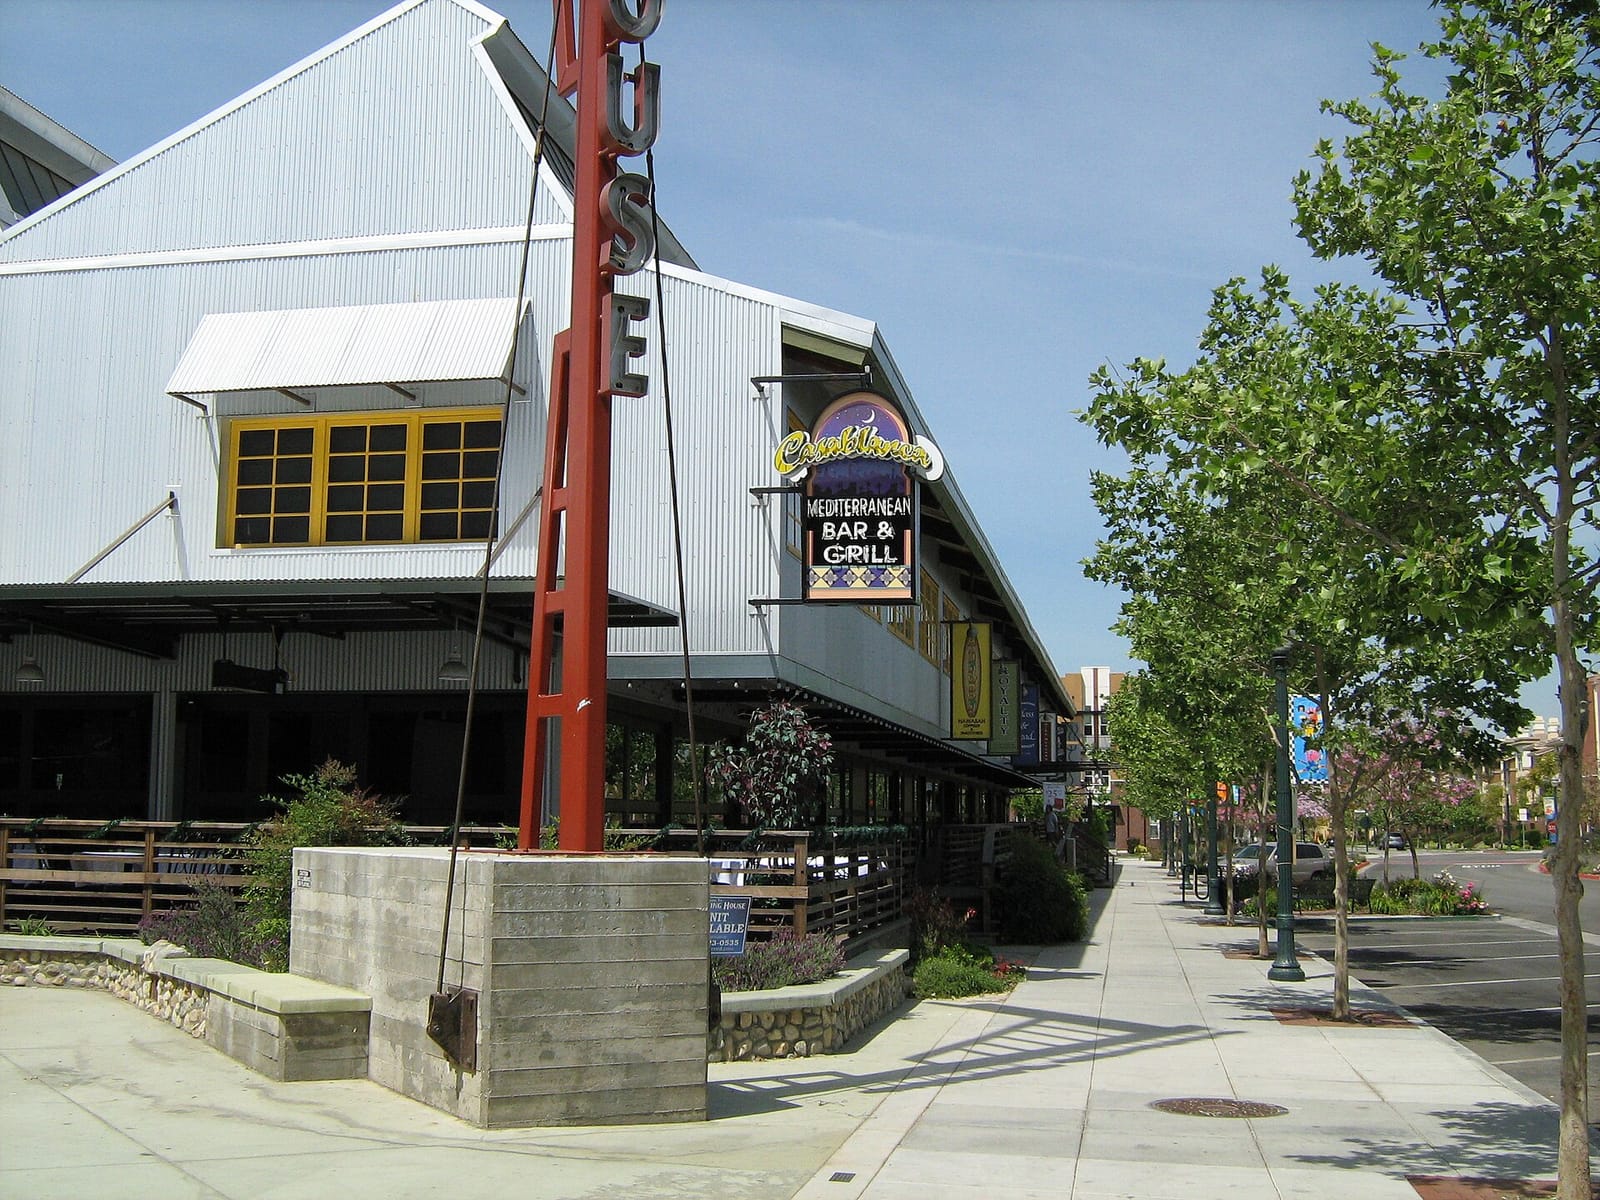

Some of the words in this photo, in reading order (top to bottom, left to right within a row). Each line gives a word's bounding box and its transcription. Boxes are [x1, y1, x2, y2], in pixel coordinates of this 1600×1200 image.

[774, 426, 931, 476] Casablanca
[807, 498, 911, 517] MEDITERRANEAN
[822, 521, 868, 540] BAR
[876, 521, 895, 540] &
[823, 544, 898, 564] GRILL
[998, 663, 1009, 737] ROYALTY
[723, 901, 746, 910] HOUSE
[710, 912, 730, 922] NIT
[709, 923, 745, 934] LABLE
